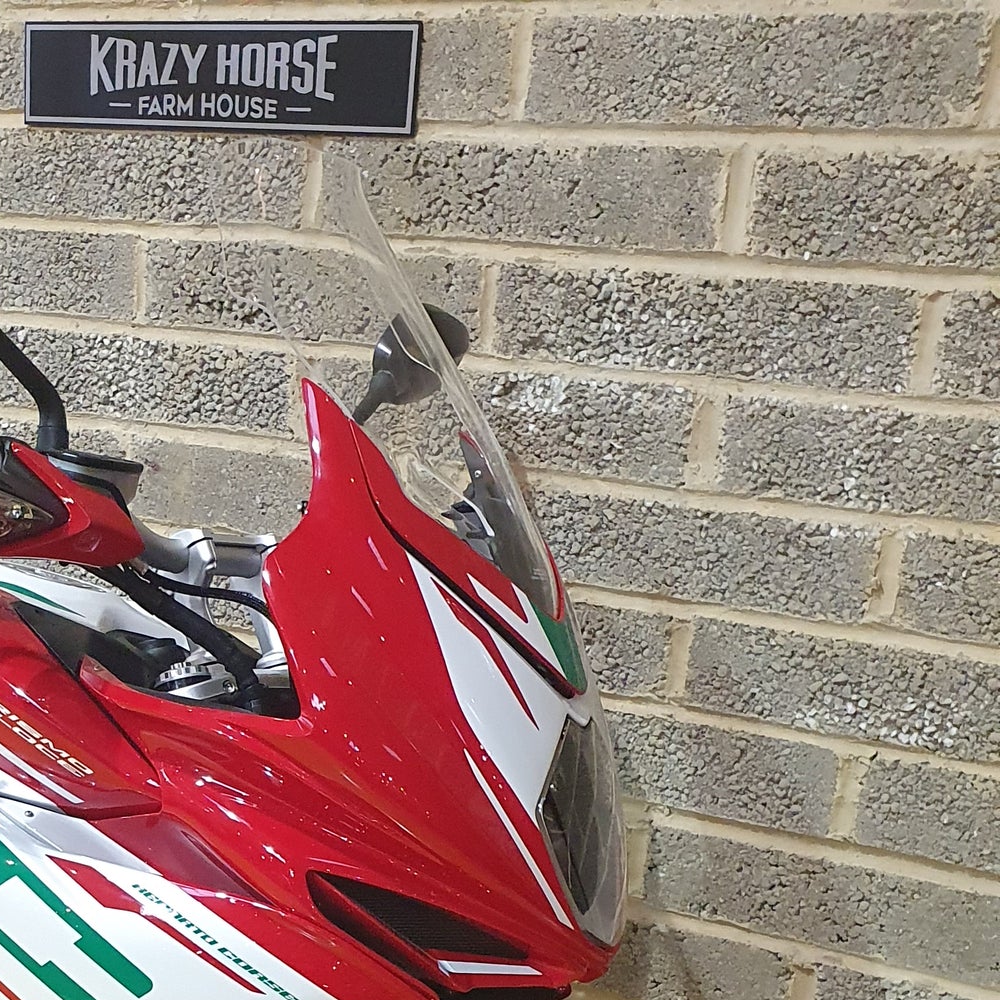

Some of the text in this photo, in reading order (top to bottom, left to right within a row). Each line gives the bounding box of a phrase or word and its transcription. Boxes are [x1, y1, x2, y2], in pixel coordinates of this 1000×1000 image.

[90, 34, 338, 101] KRAZY HORSE
[138, 93, 278, 119] FARM HOUSE
